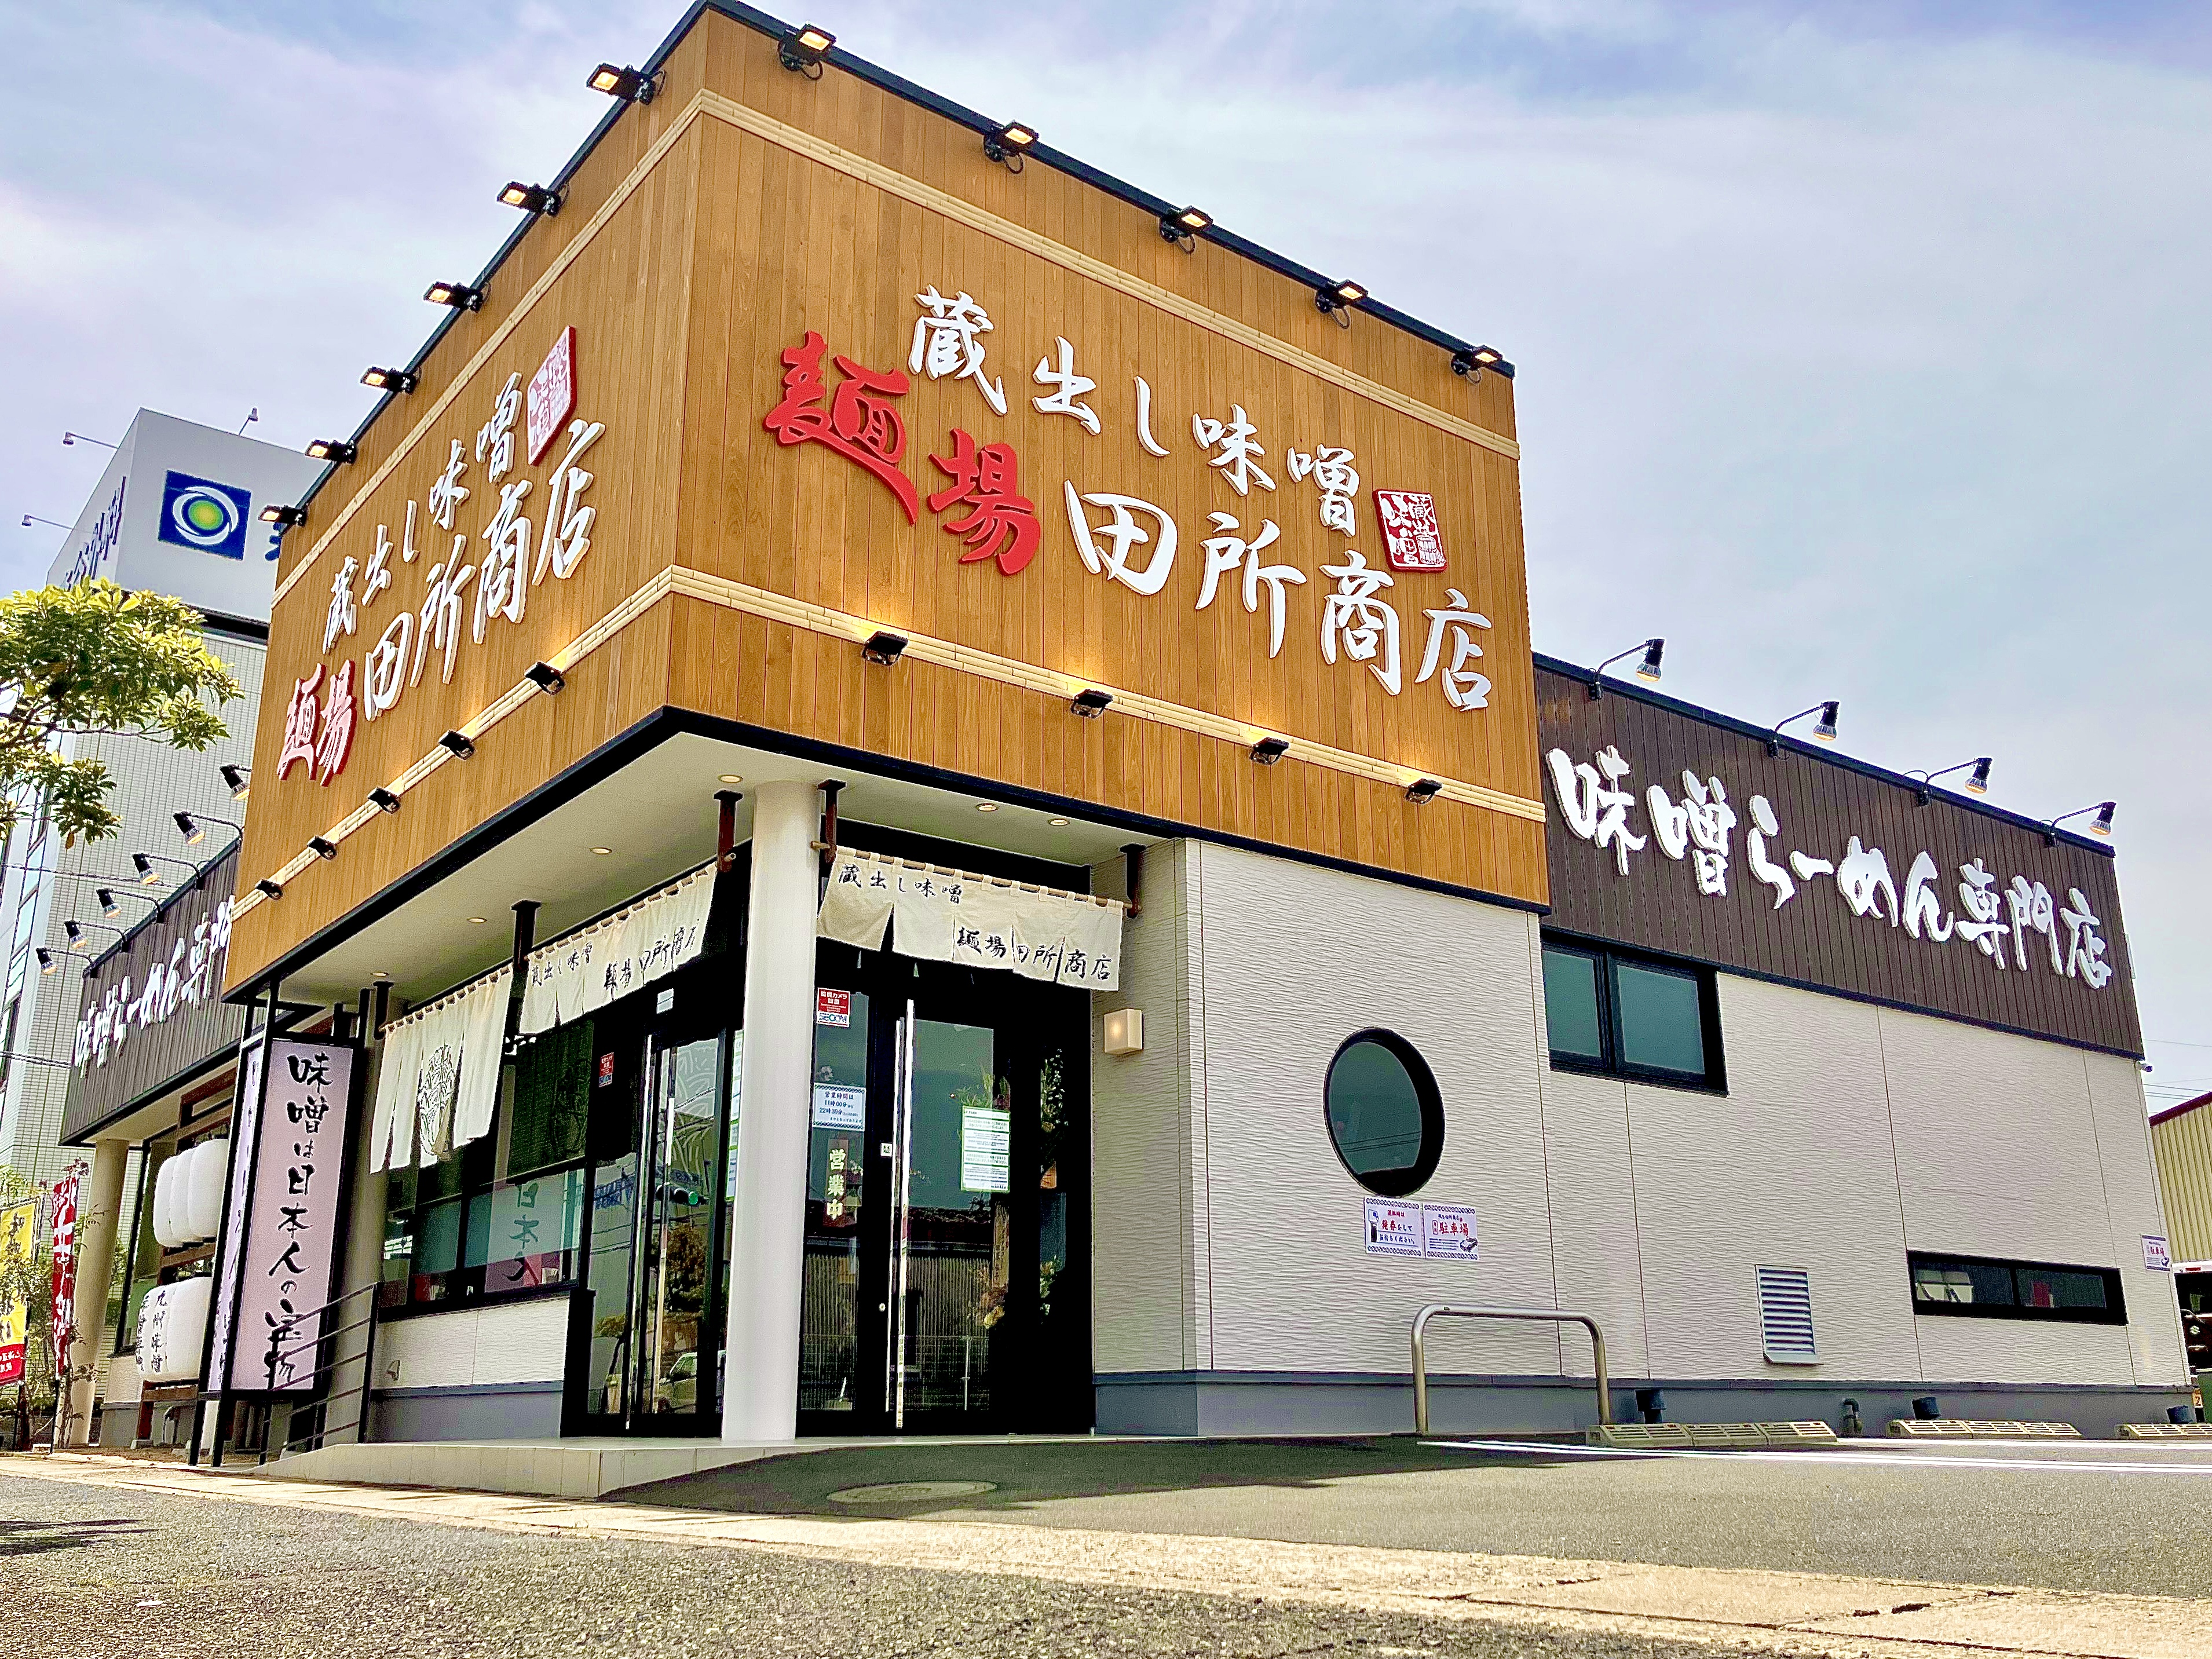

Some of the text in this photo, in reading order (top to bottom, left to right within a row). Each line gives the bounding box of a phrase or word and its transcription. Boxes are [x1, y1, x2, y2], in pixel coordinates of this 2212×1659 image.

[908, 284, 1359, 538] 蔵出し味噌
[323, 371, 523, 654] 蔵出し味噌
[839, 864, 962, 904] 蔵出し味噌
[1545, 744, 2113, 990] 味噌らーめん専門店
[819, 1013, 847, 1024] SECOM
[827, 1149, 846, 1221] 営業中
[1439, 1221, 1469, 1237] 駐車場
